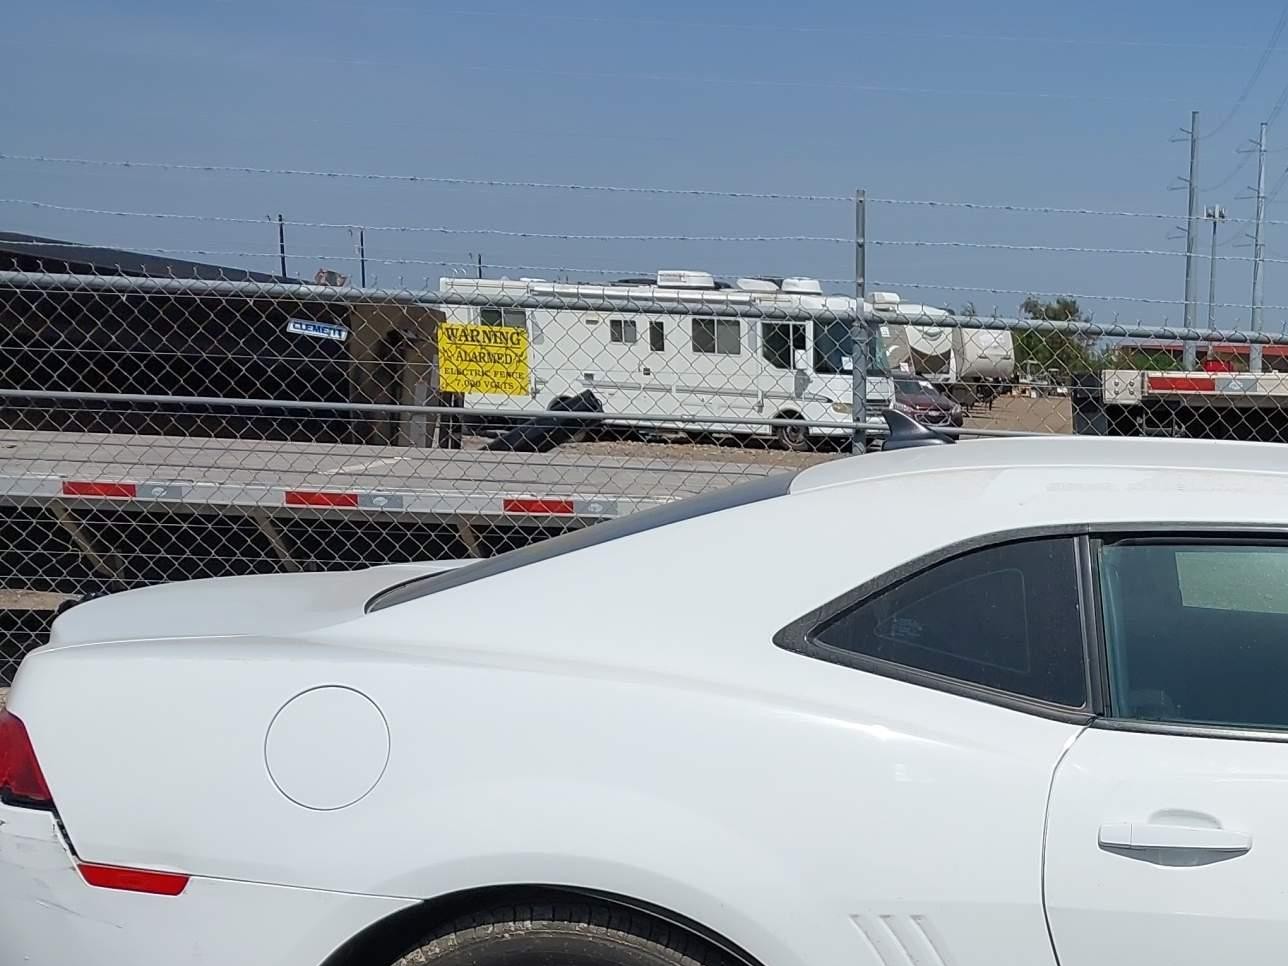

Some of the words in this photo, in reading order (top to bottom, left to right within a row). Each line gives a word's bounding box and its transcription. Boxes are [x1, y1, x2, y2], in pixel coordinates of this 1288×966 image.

[445, 327, 521, 346] WARNING
[455, 350, 513, 365] ALARMED
[444, 367, 491, 377] ELECTRIC
[493, 370, 524, 379] FENCE
[484, 380, 514, 390] VOLTS
